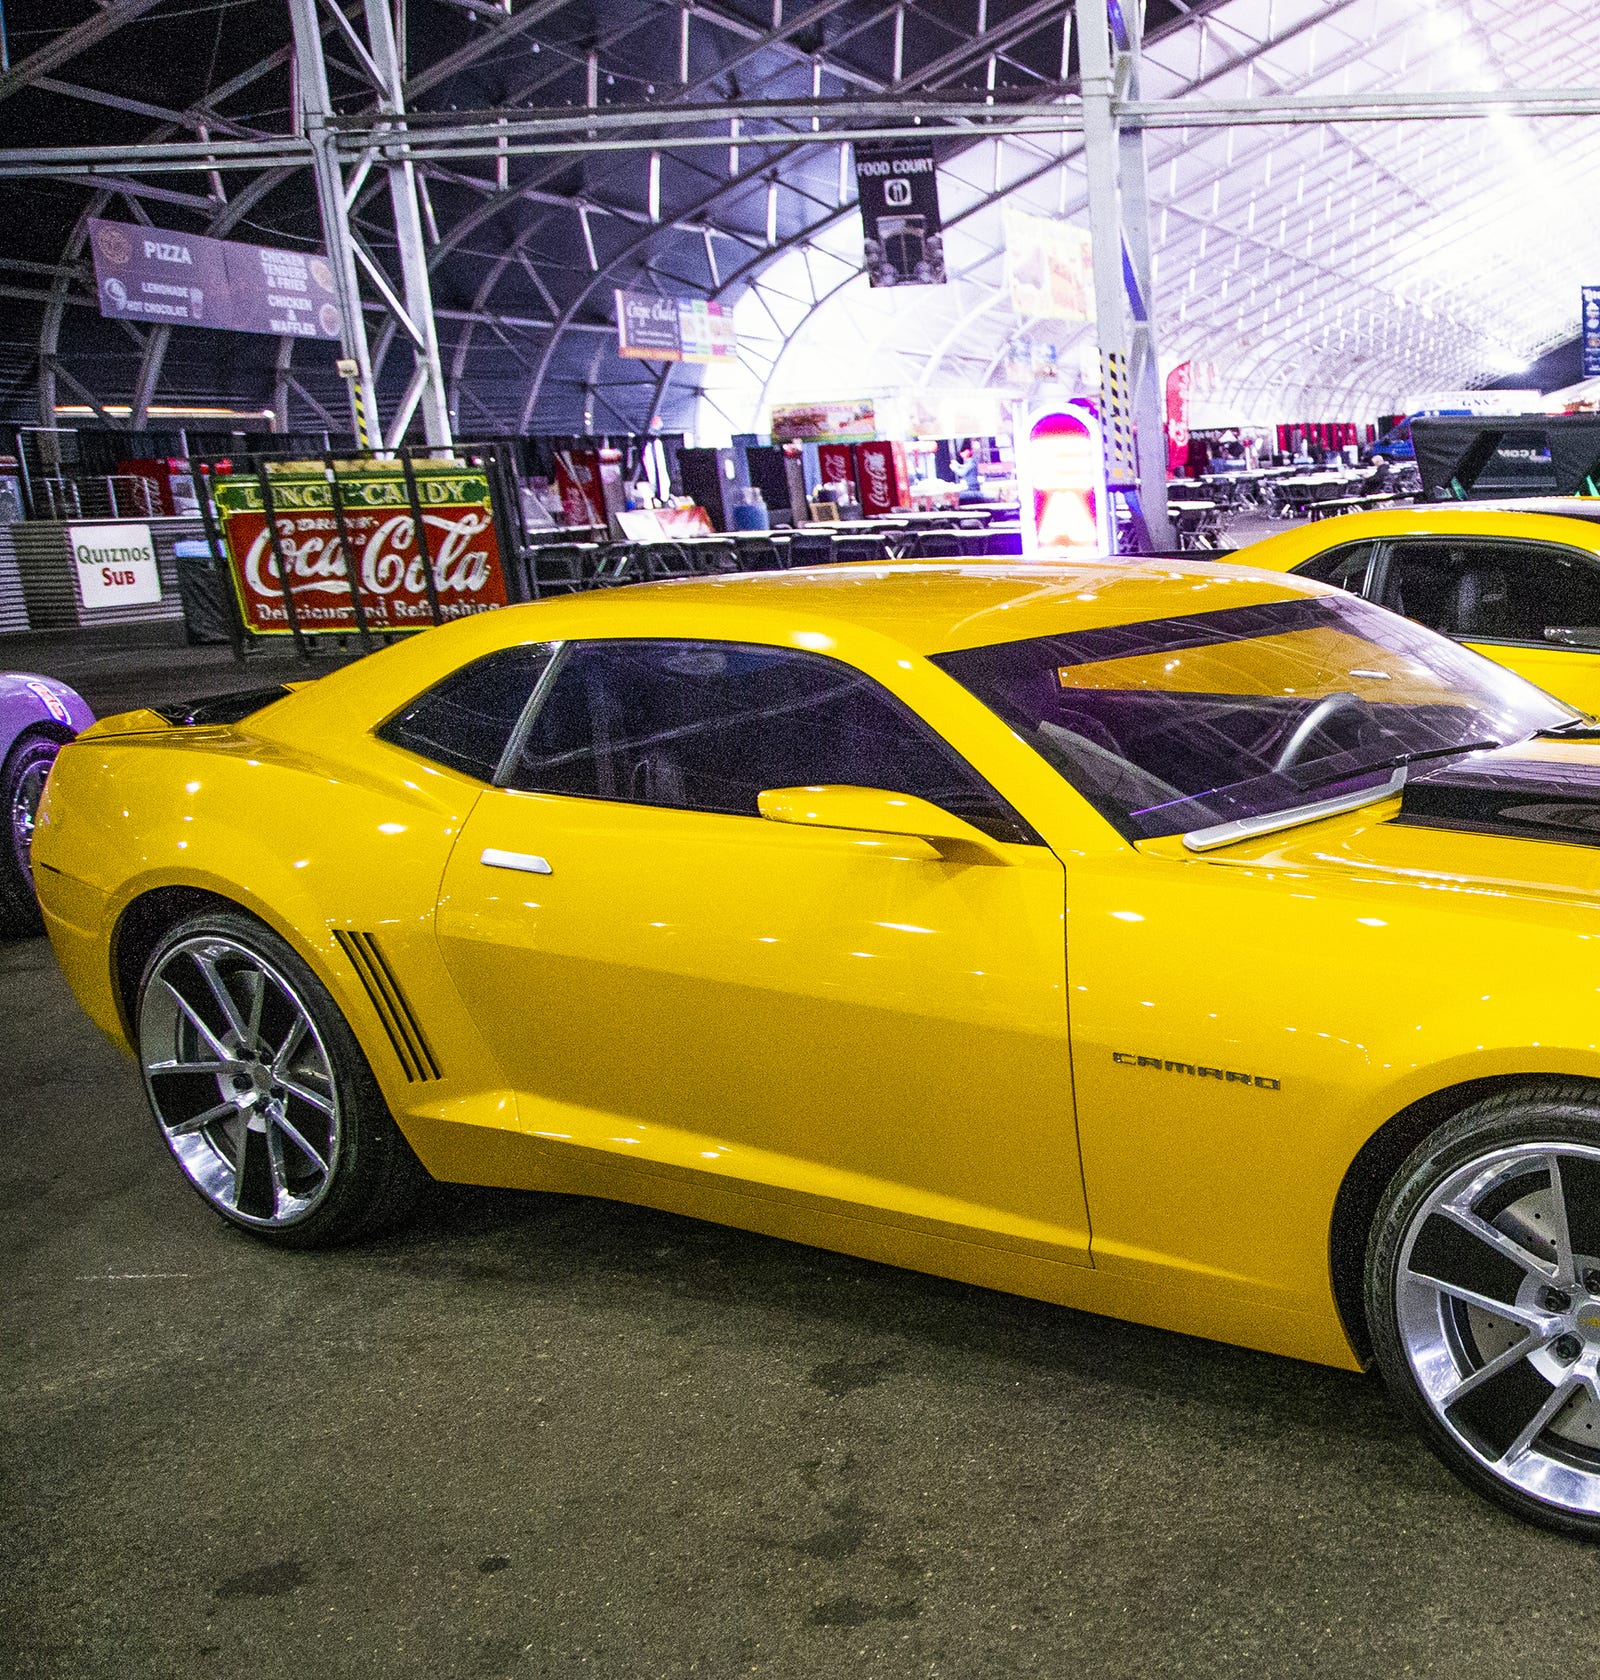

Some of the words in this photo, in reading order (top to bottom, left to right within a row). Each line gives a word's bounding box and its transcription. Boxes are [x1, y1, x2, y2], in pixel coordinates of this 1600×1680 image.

[857, 161, 890, 176] FOOD
[892, 158, 933, 174] COURT
[143, 241, 192, 265] PIZZA
[261, 249, 305, 267] CHICKEN
[277, 276, 307, 292] FRIES
[267, 294, 313, 311] CHICKEN
[271, 319, 317, 336] WAFFLES
[244, 485, 346, 507] LNCH
[244, 511, 492, 597] CocaCola
[1112, 1051, 1281, 1090] CAMARO
